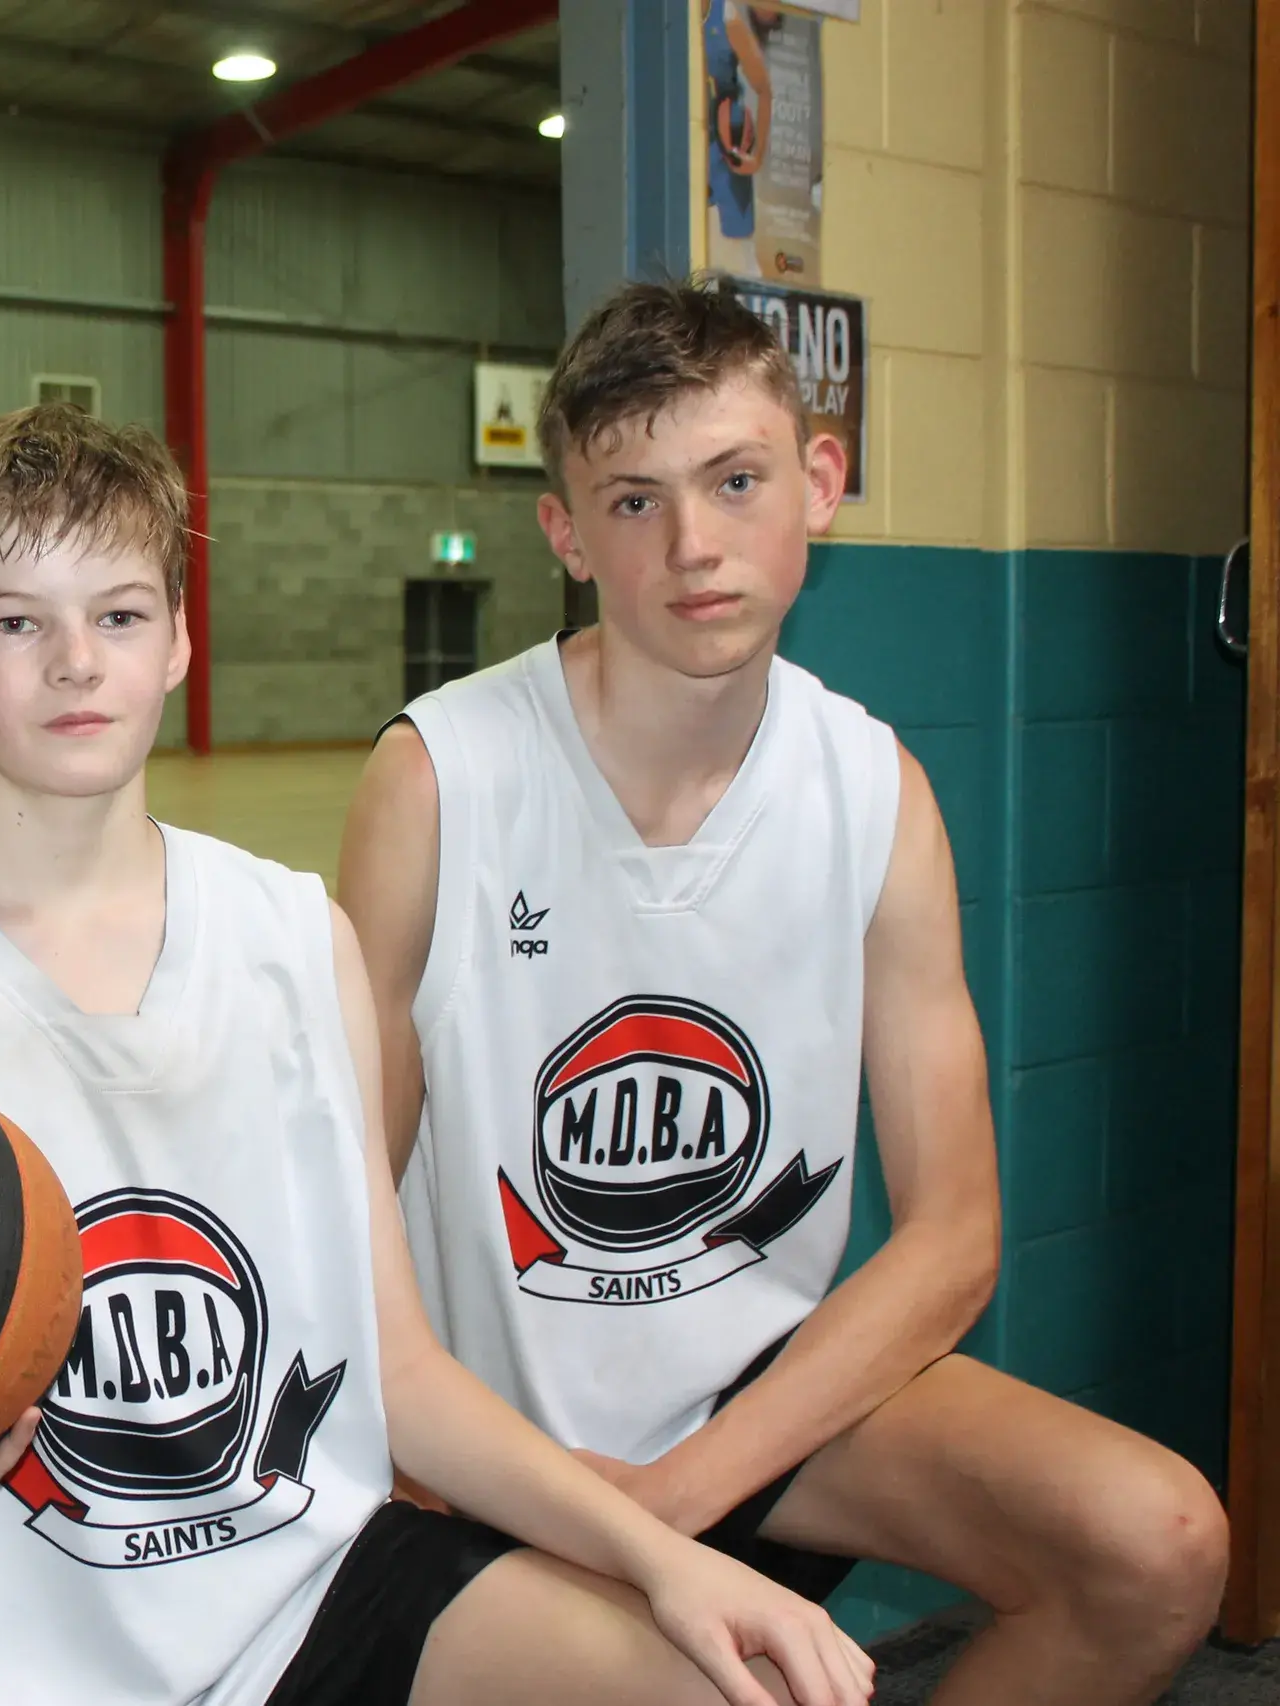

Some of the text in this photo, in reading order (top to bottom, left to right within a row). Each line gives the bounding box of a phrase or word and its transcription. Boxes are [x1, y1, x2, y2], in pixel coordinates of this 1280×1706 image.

[797, 302, 850, 384] NO
[560, 1075, 726, 1166] M.D.B.A
[588, 1269, 682, 1301] SAINTS
[124, 1515, 237, 1562] SAINTS
